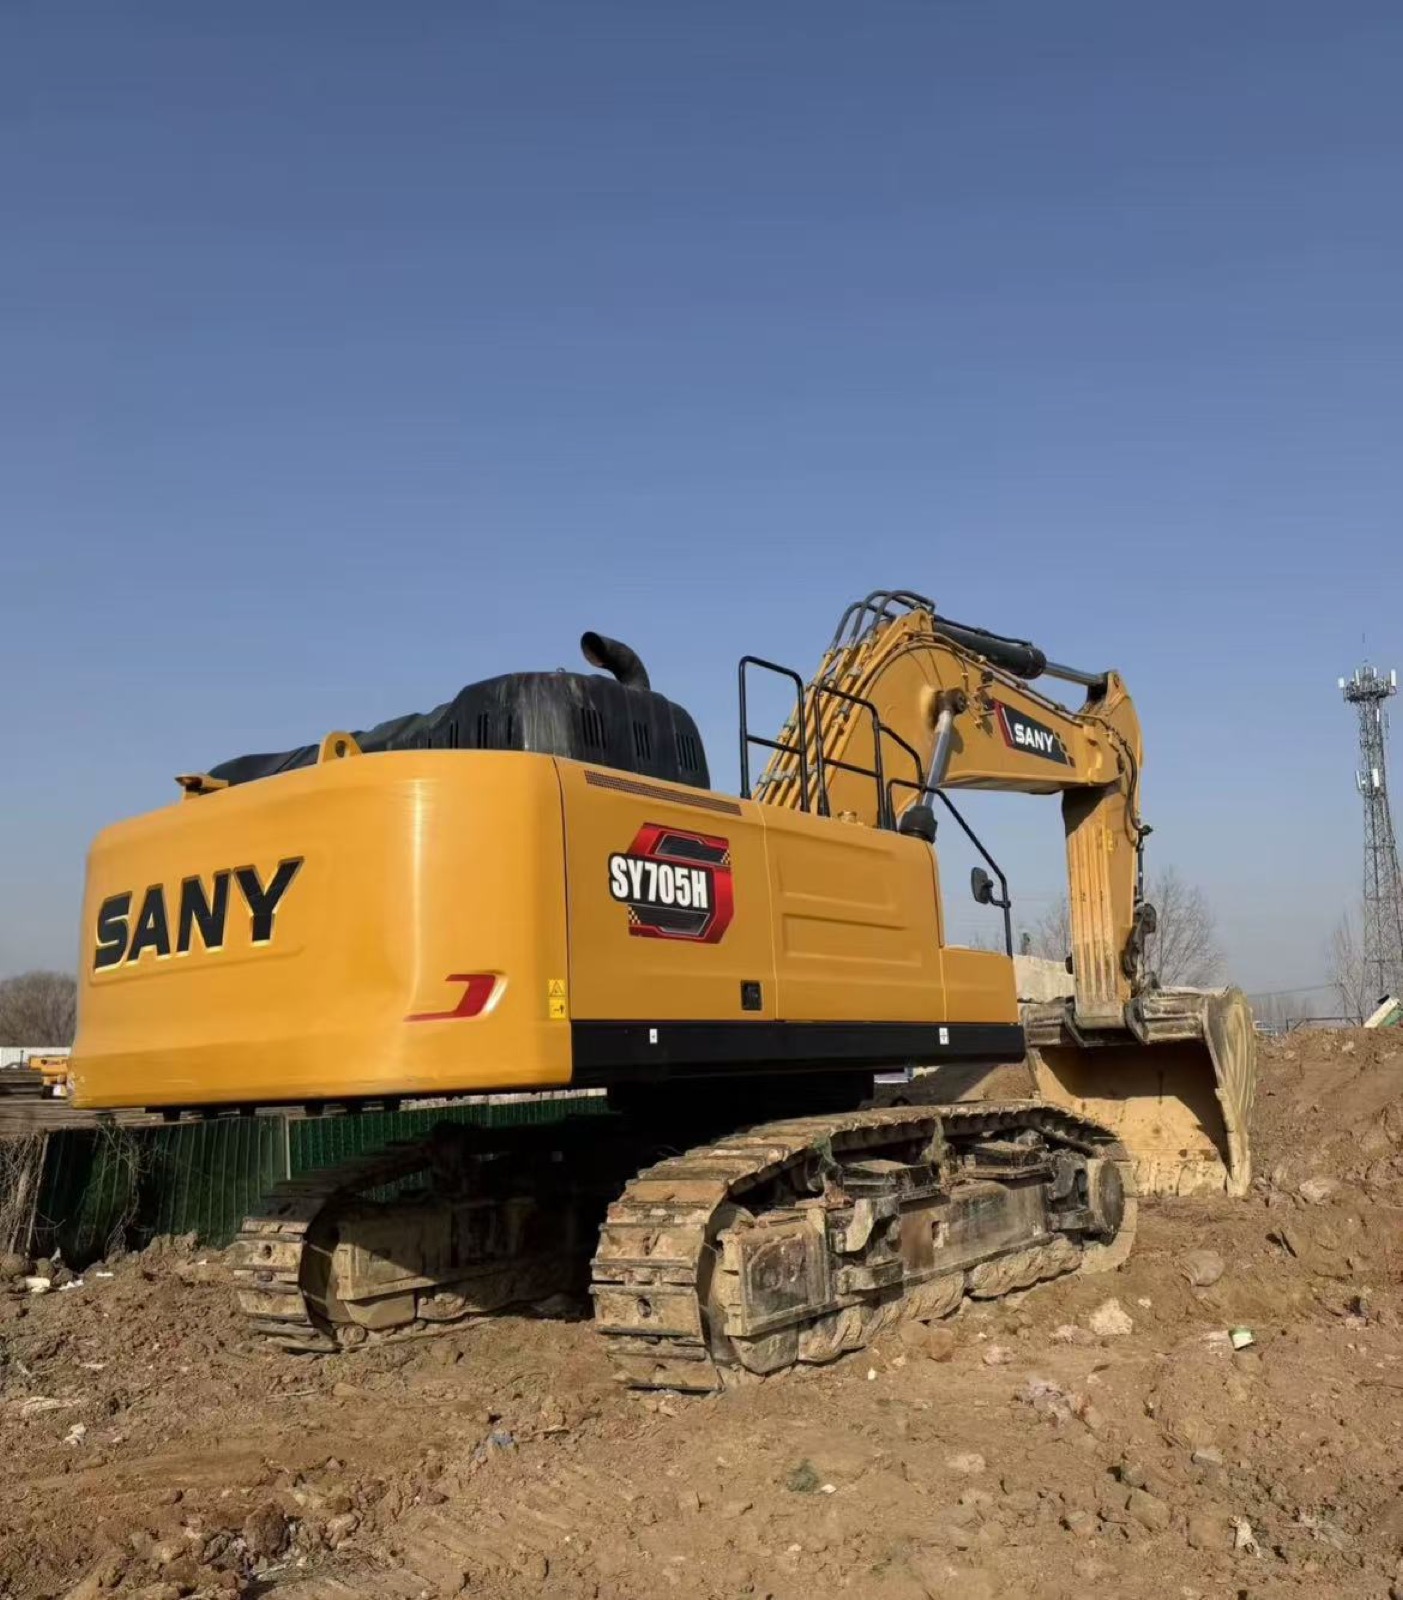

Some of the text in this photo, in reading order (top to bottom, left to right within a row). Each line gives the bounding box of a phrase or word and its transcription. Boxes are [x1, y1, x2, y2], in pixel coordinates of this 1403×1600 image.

[1014, 723, 1053, 753] SANY
[611, 856, 708, 908] SY705H
[94, 857, 304, 973] SANY
